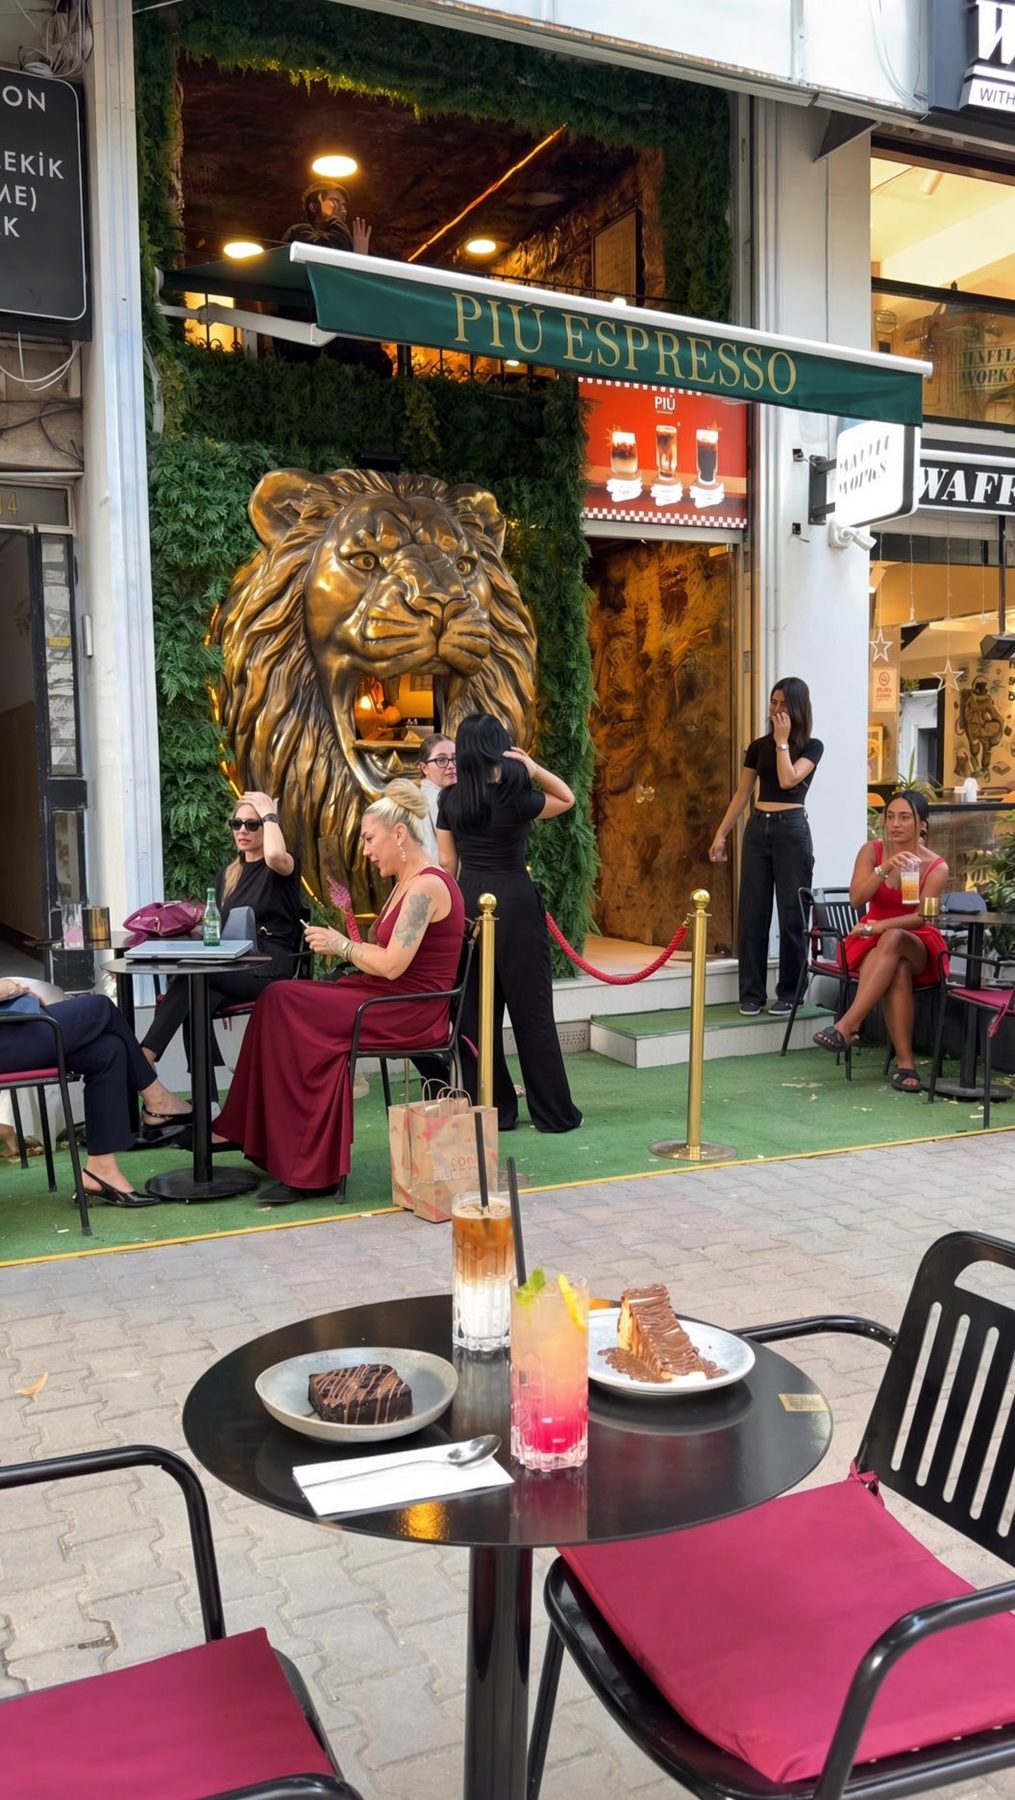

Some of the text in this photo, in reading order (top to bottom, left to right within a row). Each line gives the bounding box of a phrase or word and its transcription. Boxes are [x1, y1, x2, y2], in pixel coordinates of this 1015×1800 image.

[3, 85, 46, 112] ON
[0, 150, 64, 179] EKİK
[561, 312, 797, 395] ESPRESSO
